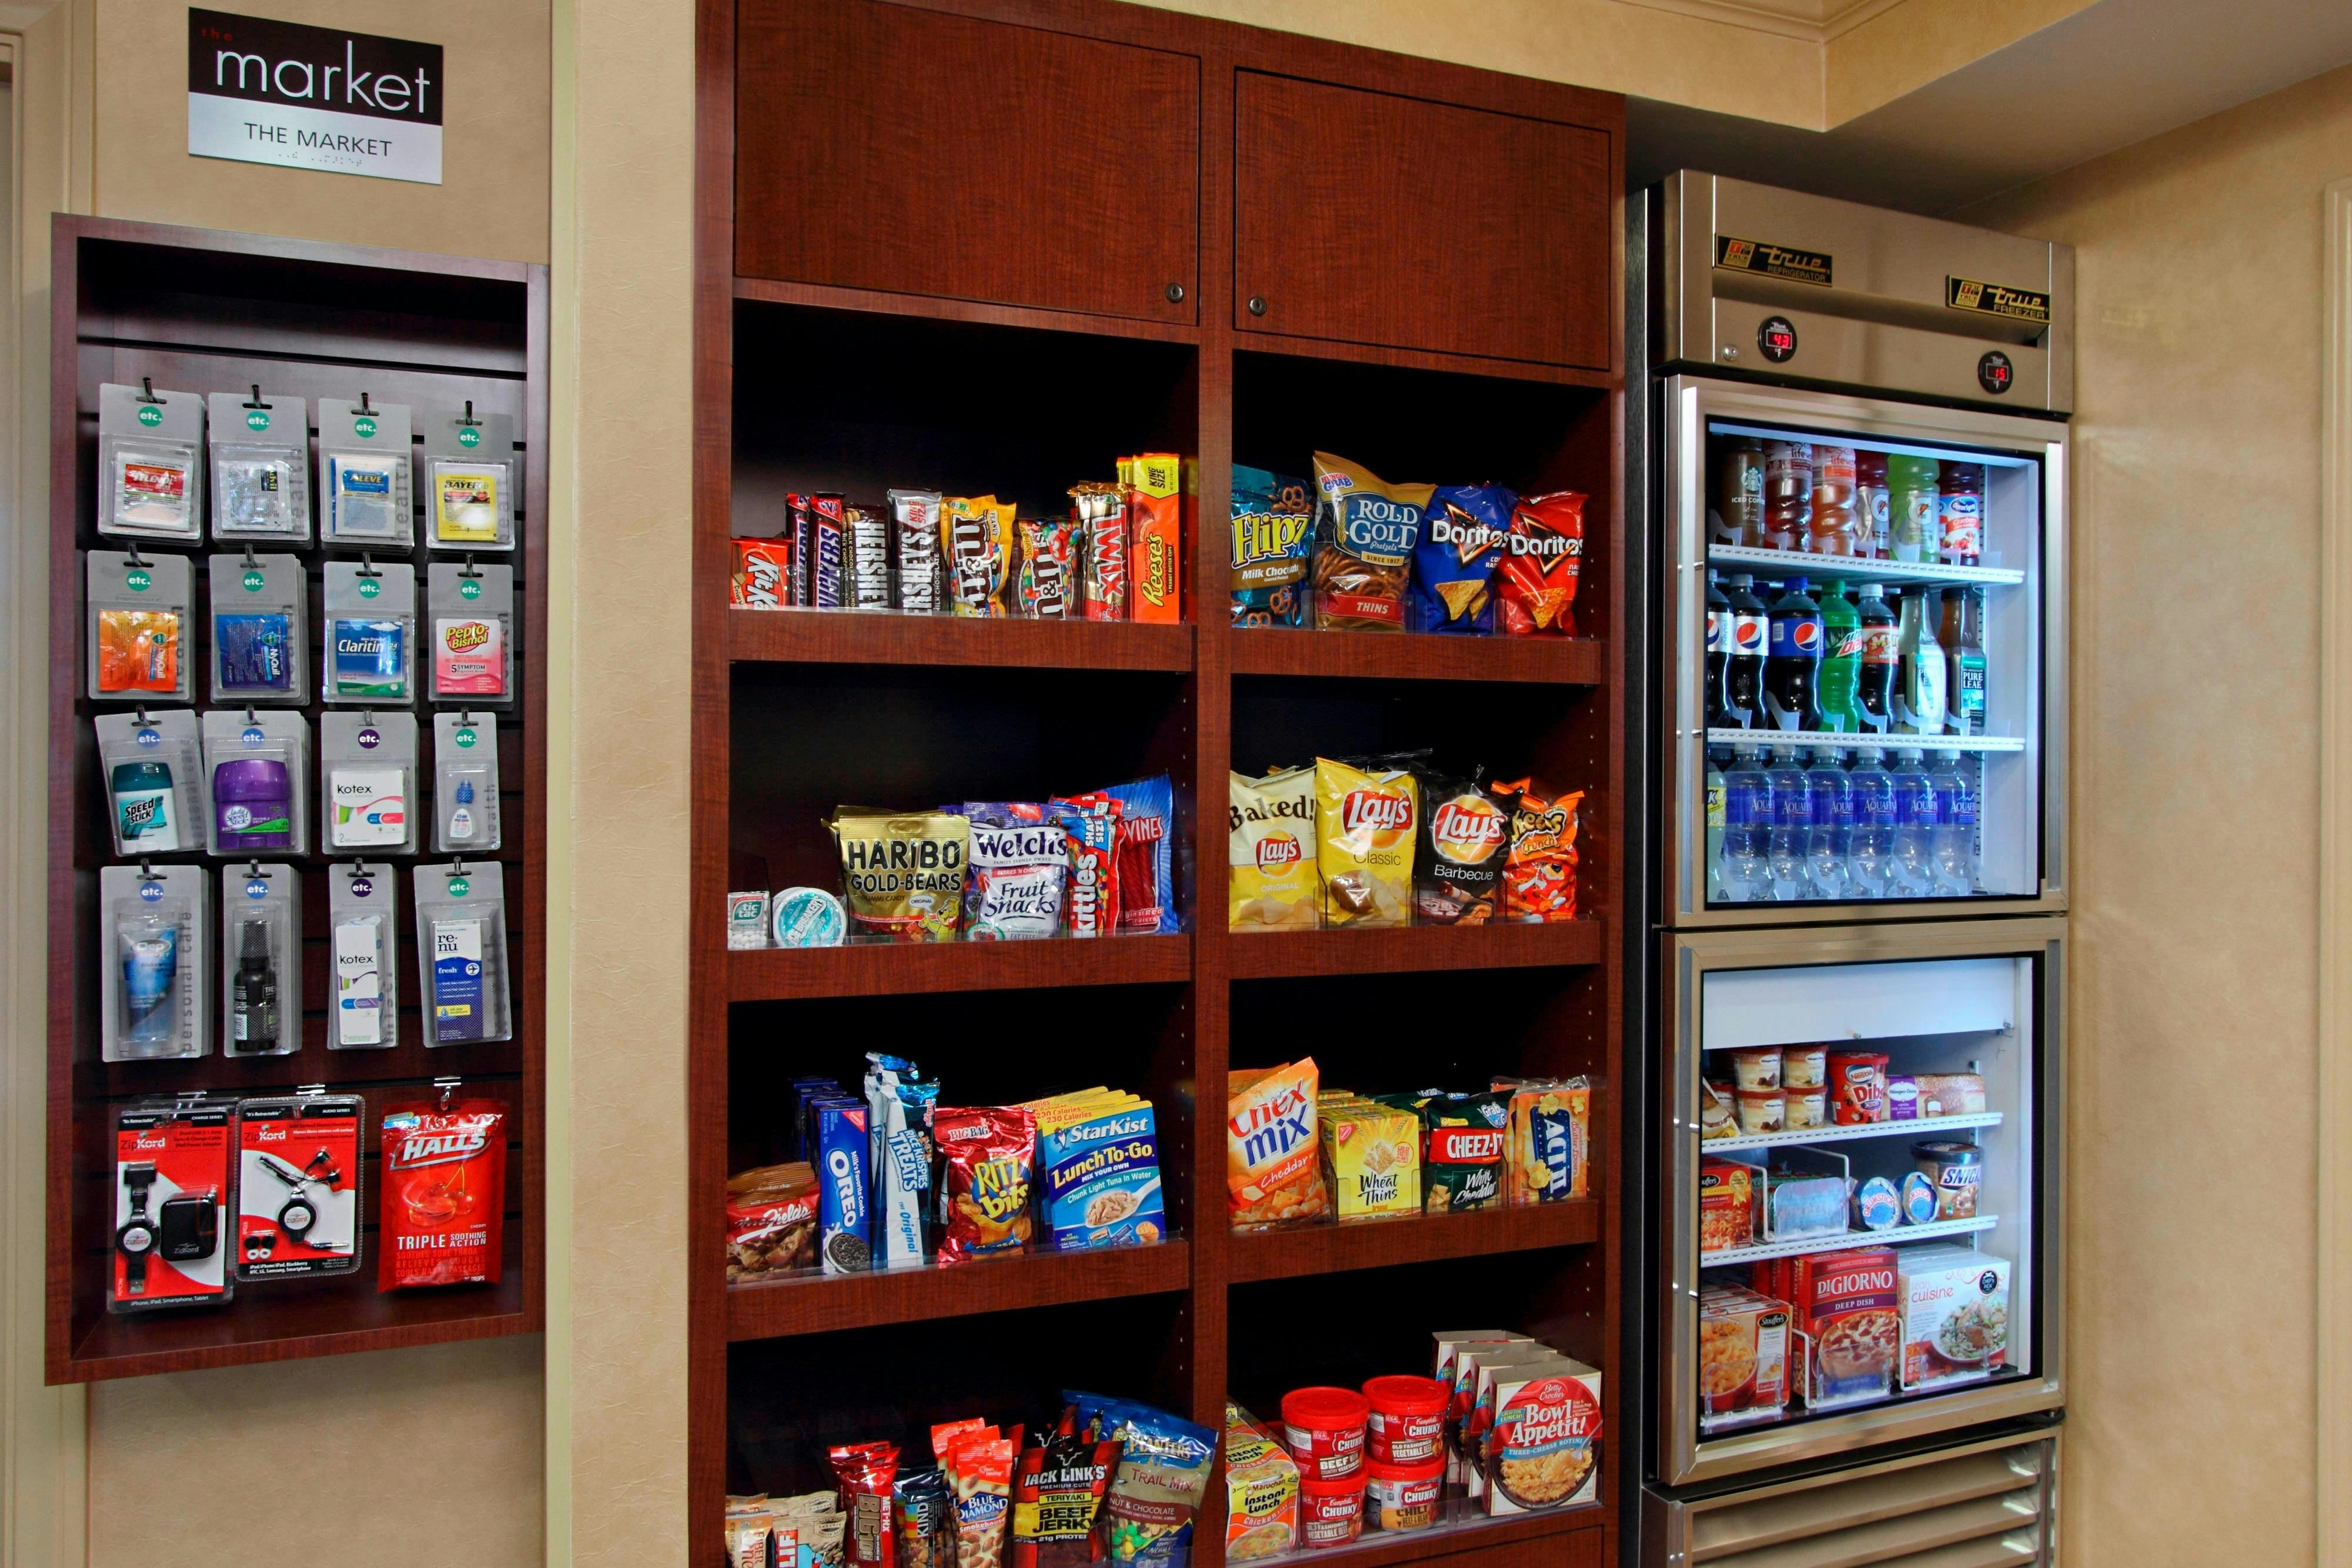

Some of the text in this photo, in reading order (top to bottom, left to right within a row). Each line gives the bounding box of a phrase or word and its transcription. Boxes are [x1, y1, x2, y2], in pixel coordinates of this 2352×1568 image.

[201, 28, 233, 42] the
[217, 40, 430, 113] market
[245, 123, 392, 157] THE MARKET
[1768, 266, 1826, 283] REFRIGERATOR
[1994, 304, 2044, 319] FREEZER
[1773, 334, 1790, 348] 43
[1995, 368, 2005, 379] 15
[140, 412, 162, 421] etc.
[248, 417, 269, 426] etc.
[356, 424, 376, 433] etc.
[350, 474, 383, 484] ALEVE
[1149, 466, 1157, 488] KING
[1157, 468, 1165, 489] SIZE
[1322, 479, 1352, 492] GRAB
[908, 501, 918, 523] KING
[918, 502, 927, 524] SIZE
[1357, 499, 1418, 524] ROLD
[989, 511, 998, 537] PEANUT
[1232, 511, 1310, 569] Flipz
[1349, 519, 1419, 549] GOLD
[1432, 520, 1509, 547] Doritos
[1093, 504, 1126, 599] TWIX
[1370, 540, 1398, 551] Pretzels
[1511, 534, 1583, 556] Doritos
[1366, 554, 1385, 563] SINCE
[128, 576, 151, 585] etc.
[1242, 564, 1299, 580] Milk Chocolate
[245, 578, 263, 586] etc.
[462, 586, 480, 594] etc.
[1357, 601, 1388, 614] THINS
[451, 632, 488, 649] Bismol
[271, 648, 280, 676] NyQuil
[1963, 671, 1983, 681] PURE
[1963, 680, 1982, 689] LEAF
[243, 734, 263, 742] etc.
[1230, 795, 1315, 833] Baked!
[1348, 793, 1409, 830] Lay's
[1124, 816, 1164, 842] VINES
[1438, 805, 1508, 844] Lay's
[974, 832, 1069, 859] Welch's
[1259, 838, 1297, 866] Lay's
[848, 840, 961, 870] HARIBO
[1354, 852, 1401, 866] Classic
[1434, 864, 1494, 881] Barbecue
[247, 885, 268, 894] etc.
[850, 873, 961, 892] GOLD-BEARS
[1000, 881, 1049, 900] Fruit
[1260, 882, 1299, 892] ORIGINAL
[738, 909, 758, 918] tac
[742, 902, 758, 911] tic
[984, 897, 1056, 918] Snacks
[1046, 1111, 1092, 1124] 230 Calories
[244, 1130, 286, 1143] ZipKord
[948, 1125, 989, 1141] BIG BAG
[1070, 1117, 1148, 1143] StarKist
[1244, 1103, 1311, 1168] mix
[121, 1138, 165, 1151] ZipKord
[403, 1129, 487, 1162] HALLS
[1447, 1132, 1504, 1159] CHEEZ-IT
[888, 1132, 918, 1192] TREATS
[1051, 1142, 1154, 1189] Lunch To-Go
[974, 1157, 1024, 1195] RITZ
[1081, 1162, 1130, 1182] MIX YOUR OWN
[1260, 1155, 1308, 1189] Cheddar
[1465, 1168, 1492, 1190] White
[828, 1149, 857, 1228] OREO
[1067, 1171, 1152, 1203] Chunk Light Tuna In Water
[1359, 1173, 1399, 1192] Wheat
[978, 1182, 1028, 1219] bits
[1358, 1188, 1398, 1206] Thins
[1453, 1182, 1496, 1205] Cheddar
[1862, 1191, 1895, 1216] DRUMSTICK
[397, 1234, 446, 1251] TRIPLE
[450, 1231, 486, 1241] SOOTHING
[450, 1238, 486, 1247] ACTION
[174, 1246, 199, 1254] ZipKord
[396, 1250, 430, 1259] SOOTHES
[1912, 1281, 1929, 1290] lean
[1911, 1286, 1954, 1303] cuisine
[1835, 1298, 1875, 1310] DEEP DISH
[1762, 1315, 1785, 1326] Stouffer's
[1545, 1383, 1562, 1393] Betty
[1500, 1413, 1524, 1422] LUNCH!
[1524, 1399, 1572, 1426] Bowl
[1409, 1423, 1441, 1436] CHUNKY
[1508, 1416, 1586, 1447] Appétit!
[1128, 1433, 1191, 1460] PLANTERS
[1392, 1445, 1432, 1458] VEGETABLE BEEF
[1508, 1437, 1583, 1456] THREE-CHEESE ROTINI
[1024, 1465, 1105, 1487] JACK LINK'S
[1252, 1478, 1285, 1492] Maruchan
[968, 1495, 995, 1510] BLUE
[1045, 1494, 1085, 1502] TERIYAKI
[1244, 1487, 1285, 1506] Instant
[1404, 1487, 1437, 1502] CHUNKY
[958, 1498, 1008, 1520] DIAMOND
[1038, 1506, 1093, 1520] BEEF
[1110, 1497, 1124, 1506] NUT
[1132, 1503, 1175, 1515] CHOCOLATE
[1248, 1498, 1280, 1514] Lunch
[1323, 1503, 1357, 1517] CHUNKY
[917, 1502, 928, 1537] KIND
[959, 1517, 1007, 1533] Smokehouse
[1032, 1518, 1097, 1533] JERKY
[754, 1531, 764, 1565] FIBER
